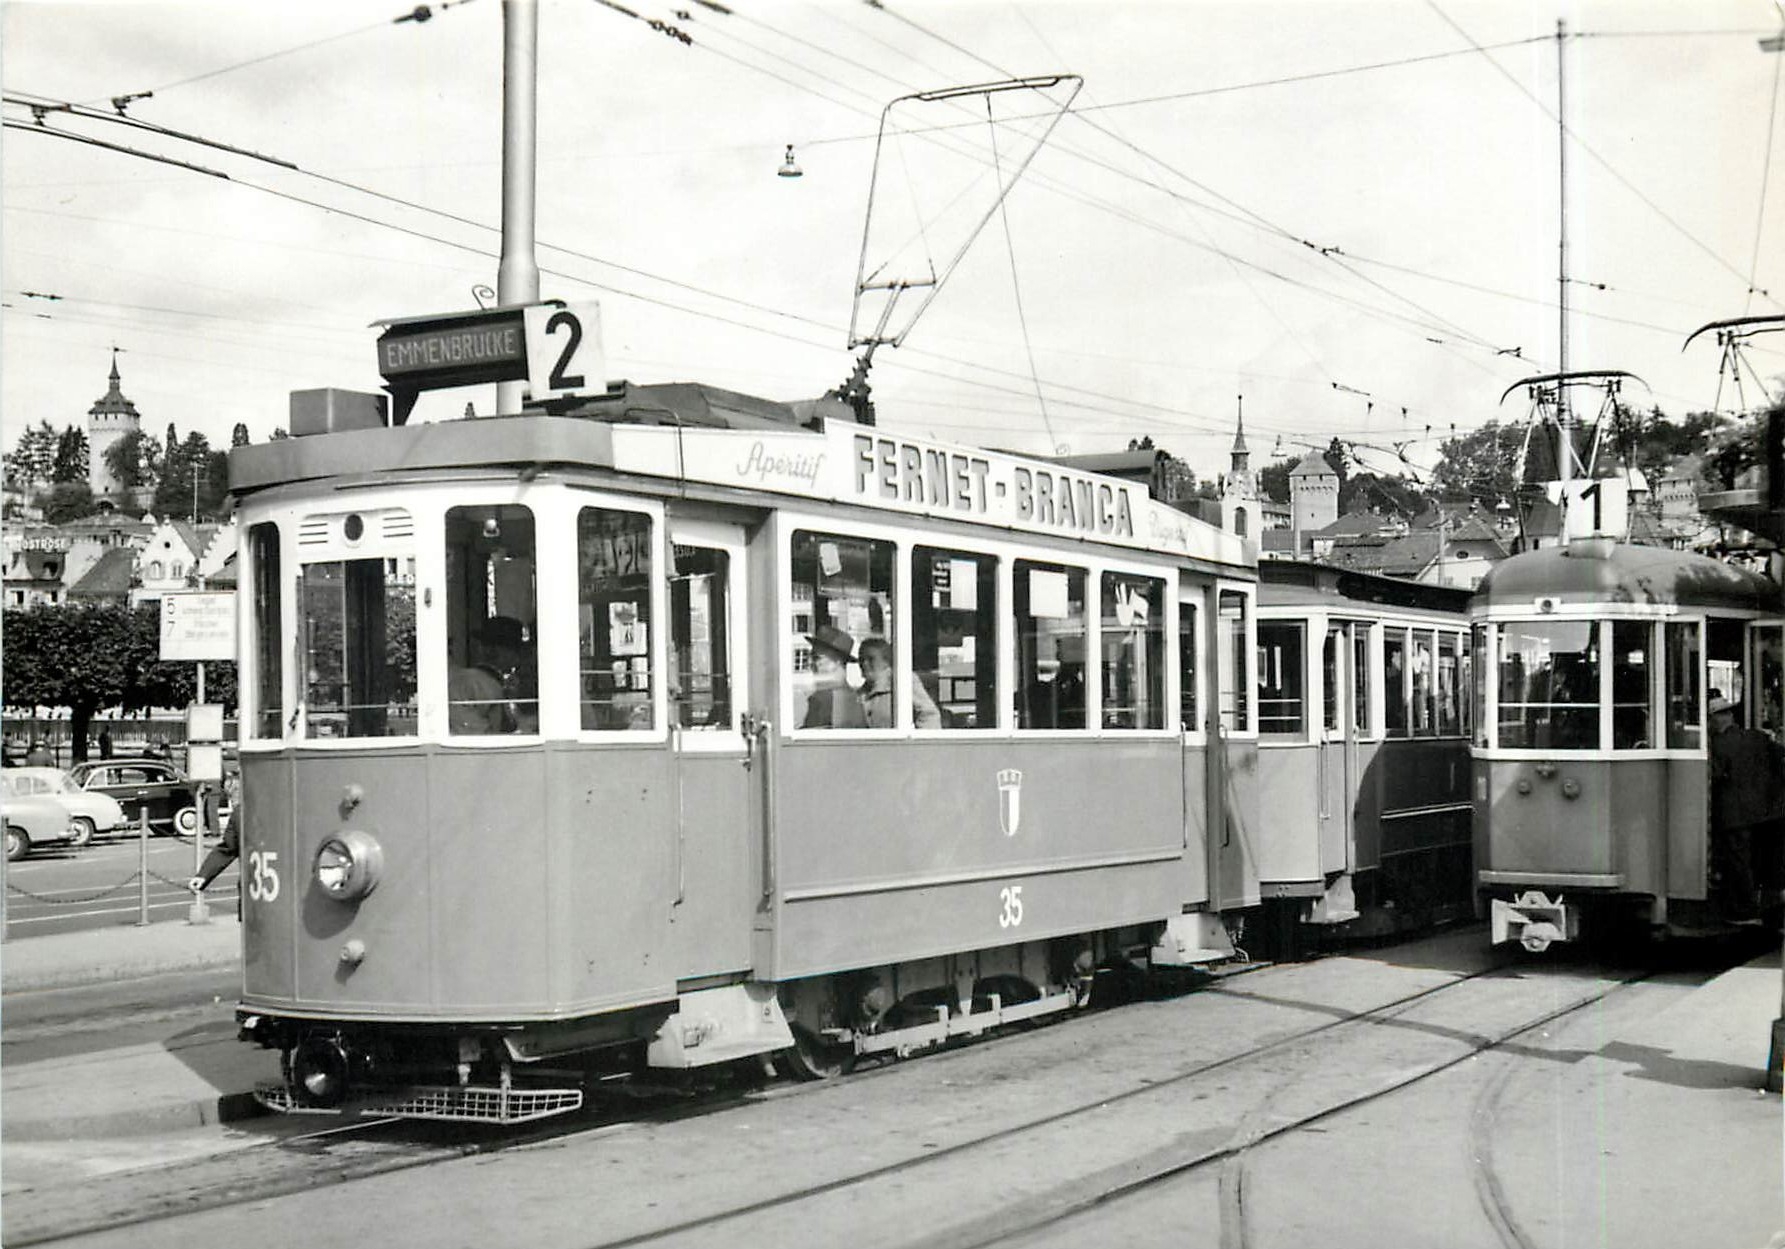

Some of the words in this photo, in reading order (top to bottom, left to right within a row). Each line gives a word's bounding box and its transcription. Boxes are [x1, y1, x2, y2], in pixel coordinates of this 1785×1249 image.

[545, 311, 584, 390] 2
[1580, 483, 1600, 530] 1
[167, 597, 176, 615] 5
[167, 621, 176, 638] 7
[249, 850, 280, 902] 35
[999, 886, 1024, 928] 35
